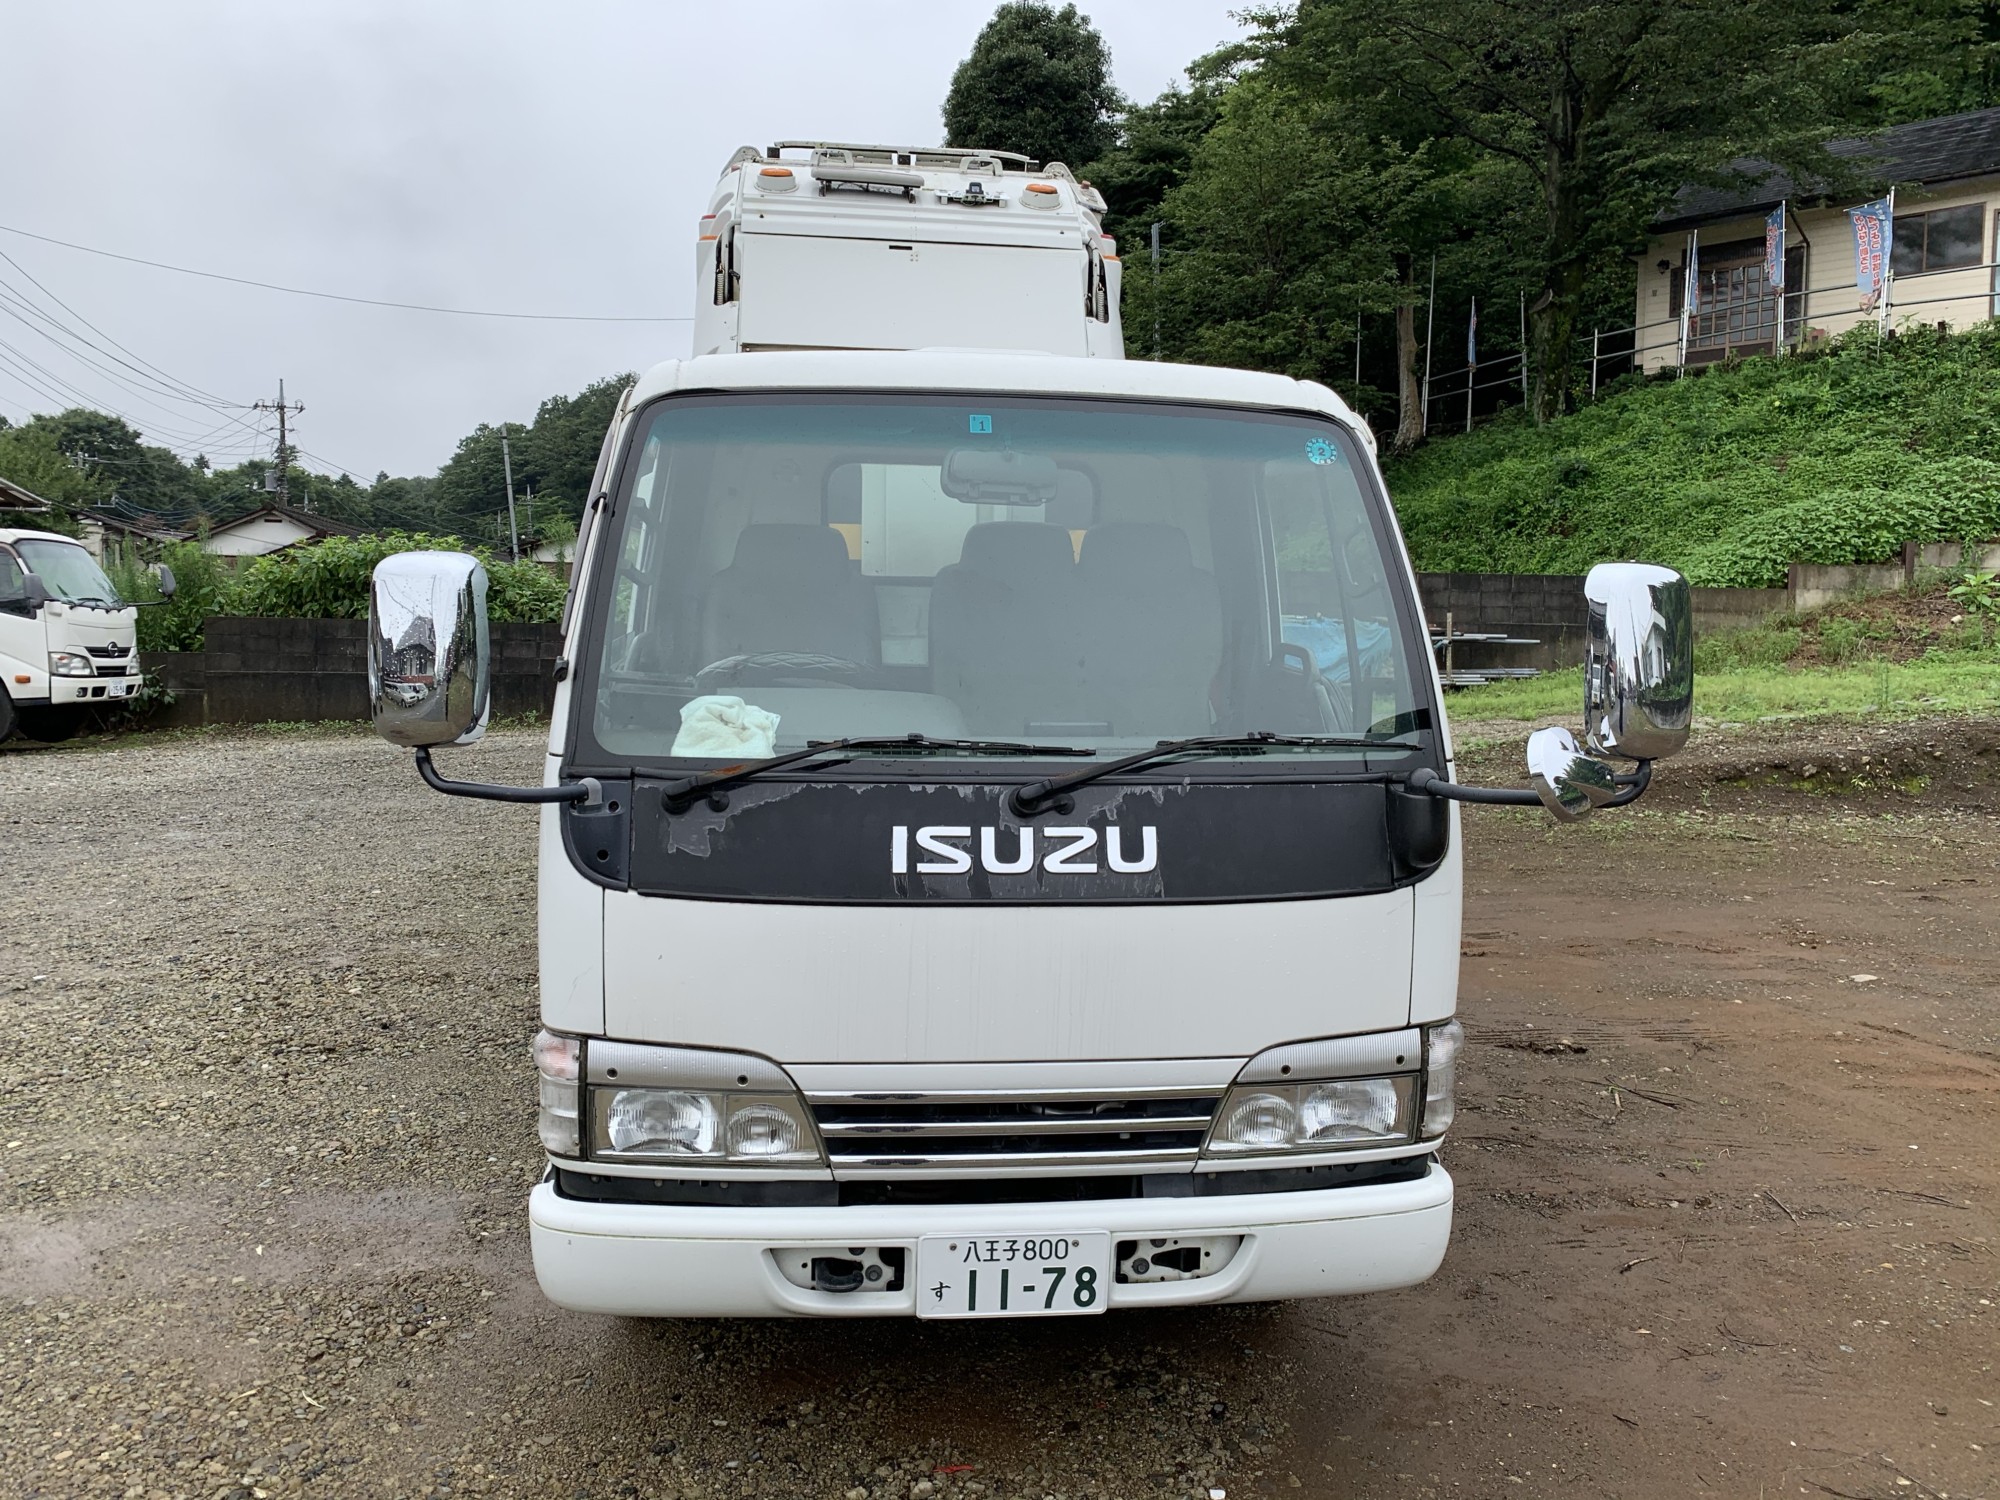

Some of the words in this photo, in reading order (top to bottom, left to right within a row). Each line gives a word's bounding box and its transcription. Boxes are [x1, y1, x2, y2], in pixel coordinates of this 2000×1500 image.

[891, 825, 1158, 874] ISUZU
[930, 1281, 951, 1302] す
[968, 1266, 1097, 1311] 11-78
